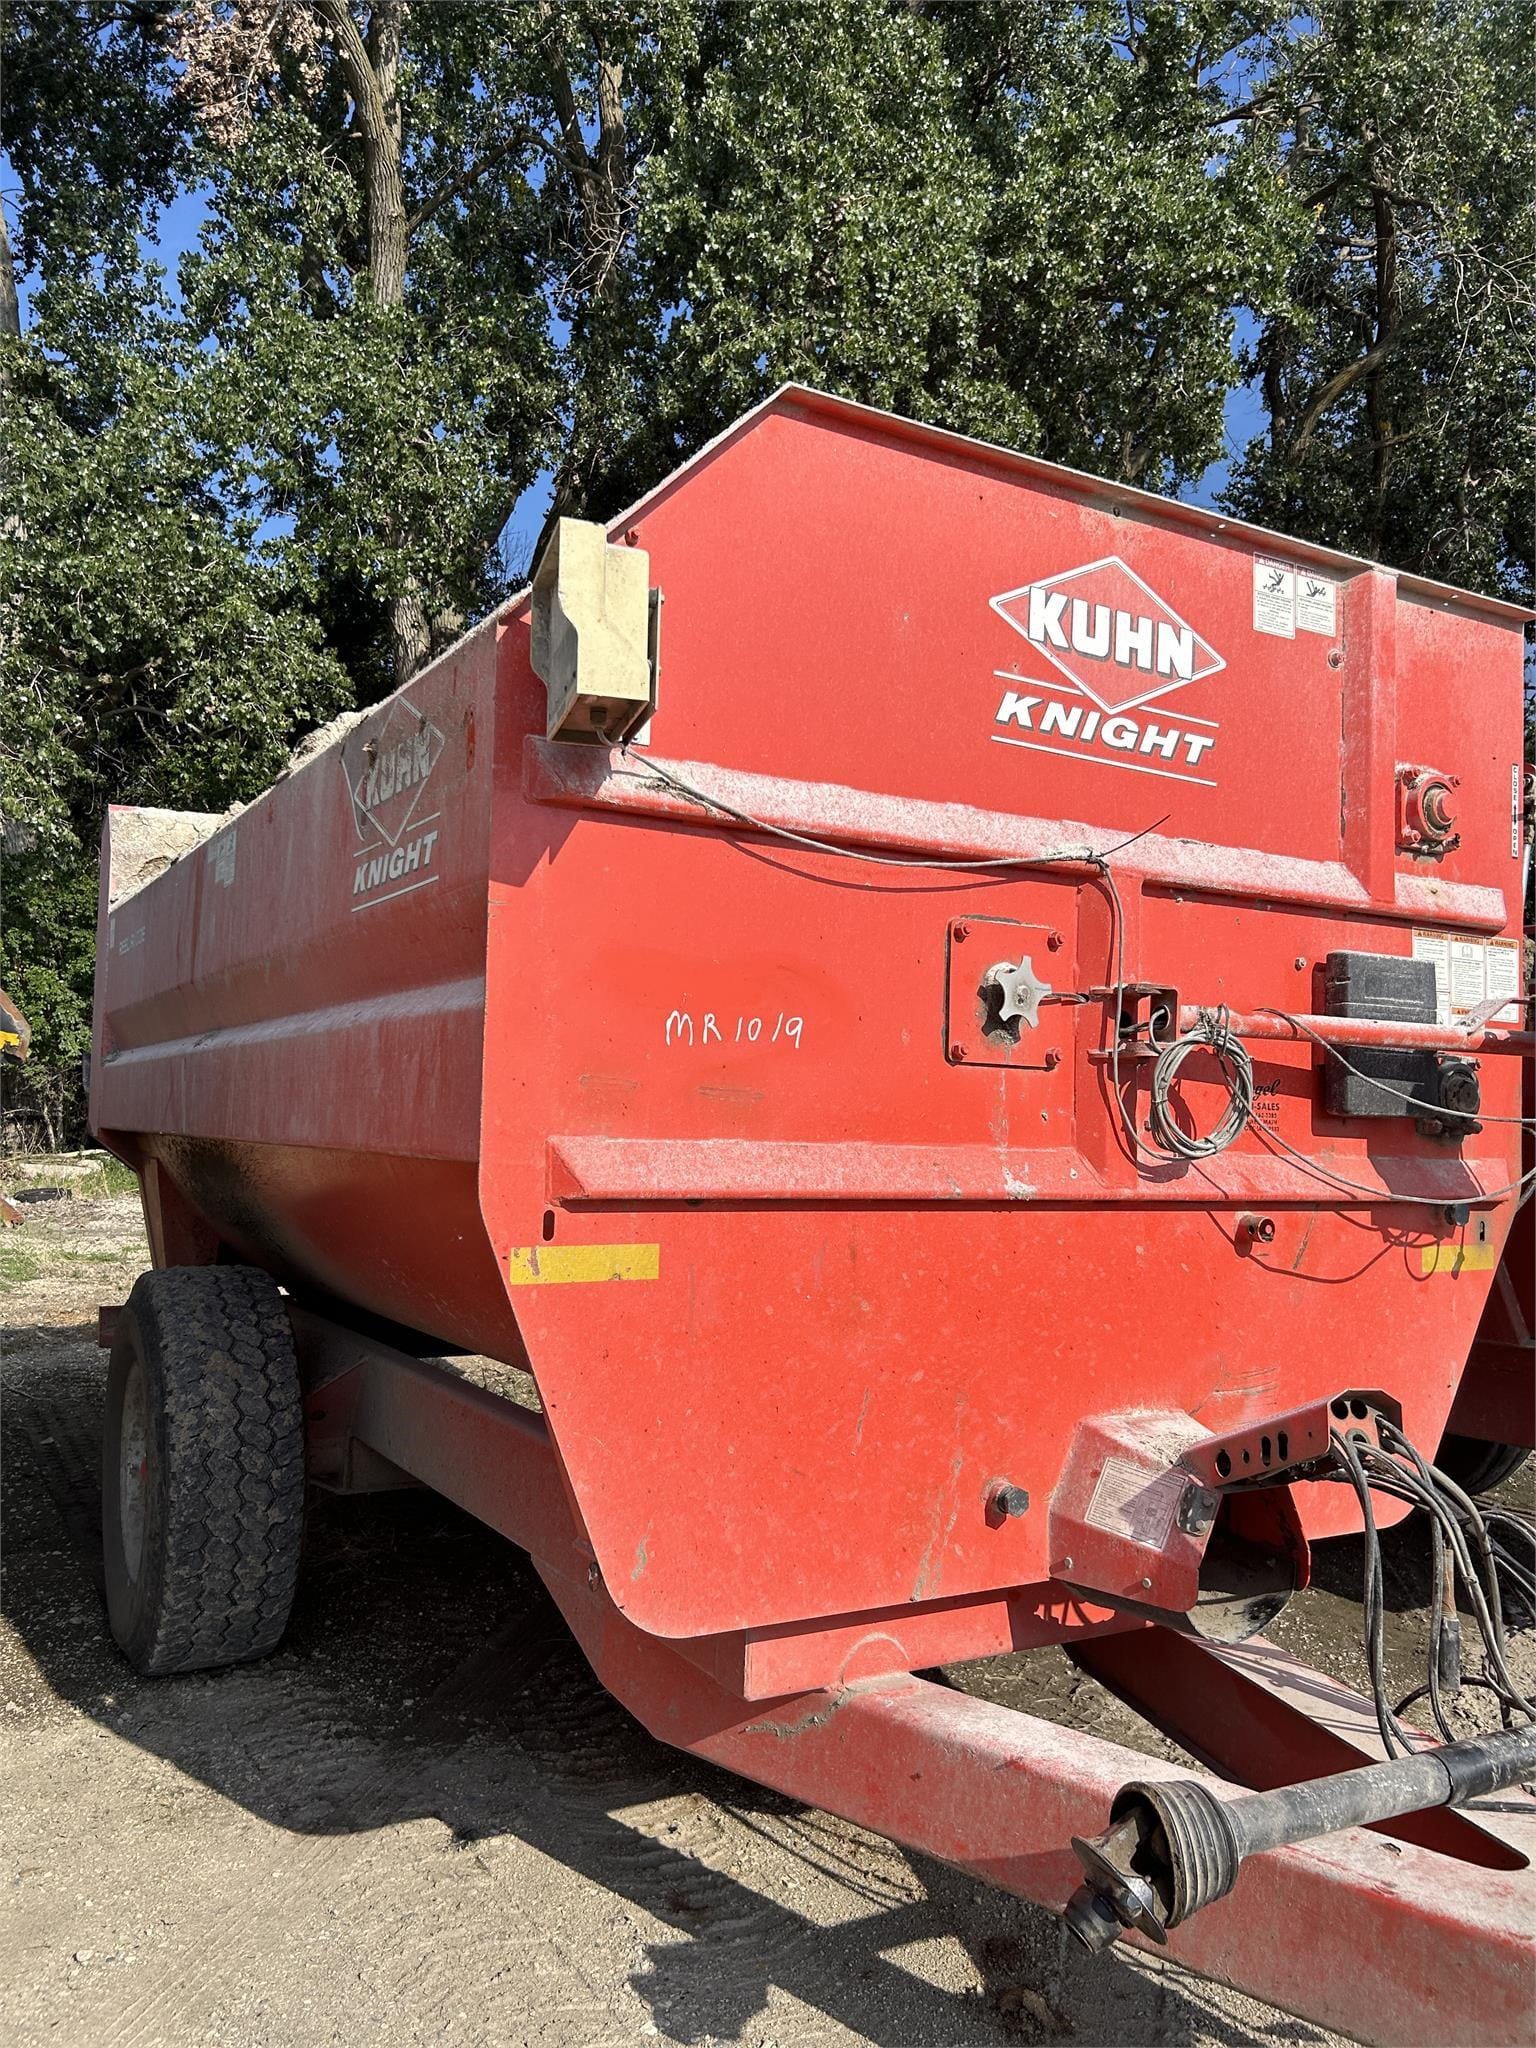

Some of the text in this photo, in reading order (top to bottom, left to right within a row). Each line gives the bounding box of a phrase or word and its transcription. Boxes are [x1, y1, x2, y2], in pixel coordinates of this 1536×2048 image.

[1028, 586, 1193, 682] KUHN
[995, 691, 1215, 765] KNIGHT
[353, 830, 438, 895] KNIGHT
